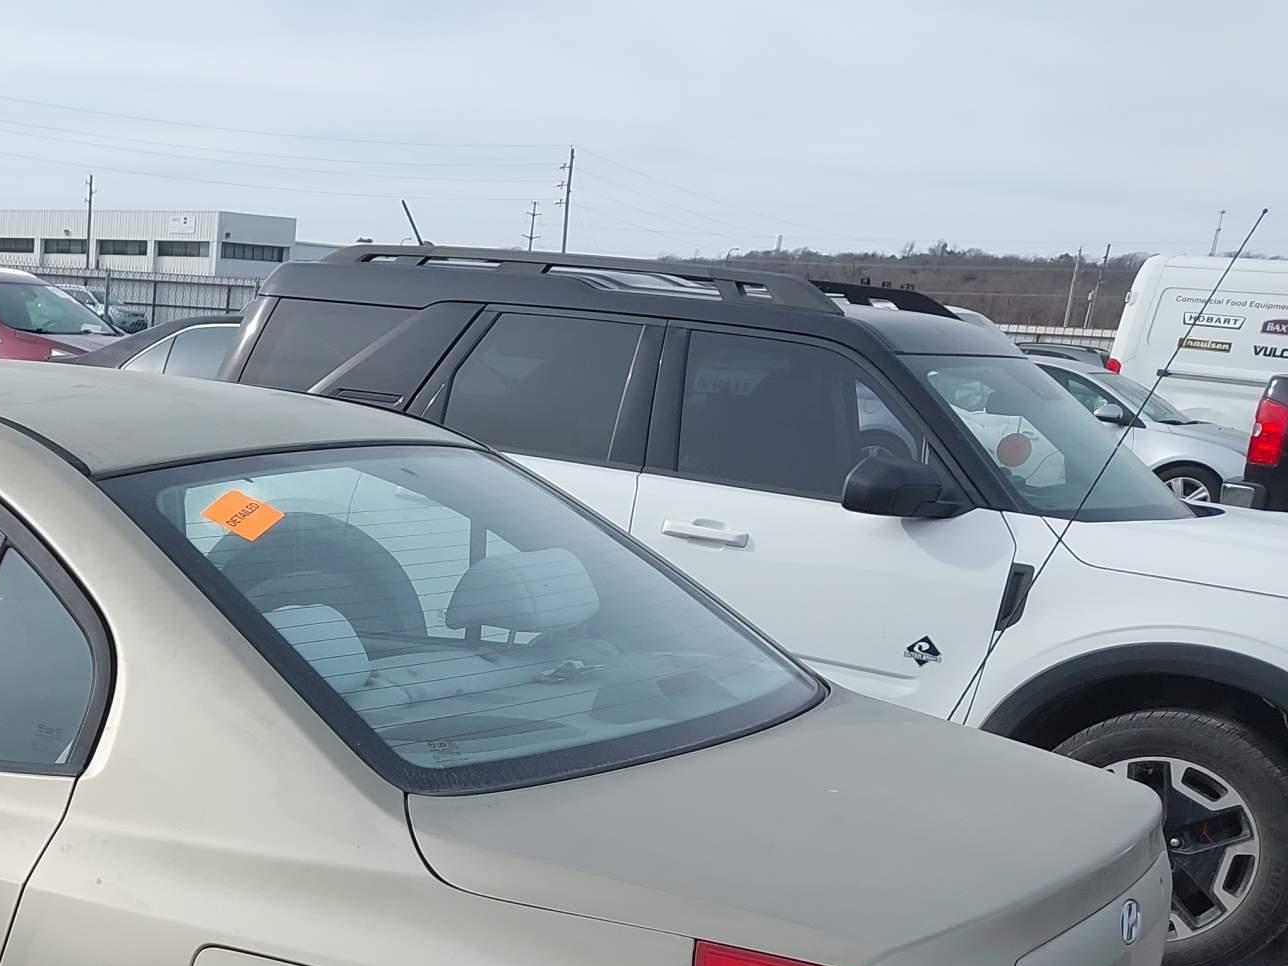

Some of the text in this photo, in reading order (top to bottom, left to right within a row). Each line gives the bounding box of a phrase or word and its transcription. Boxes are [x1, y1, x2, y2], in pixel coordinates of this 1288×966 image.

[1225, 299, 1247, 307] Food
[1188, 314, 1240, 326] HOBART
[1266, 321, 1288, 333] BAX
[225, 502, 260, 528] DETAILED
